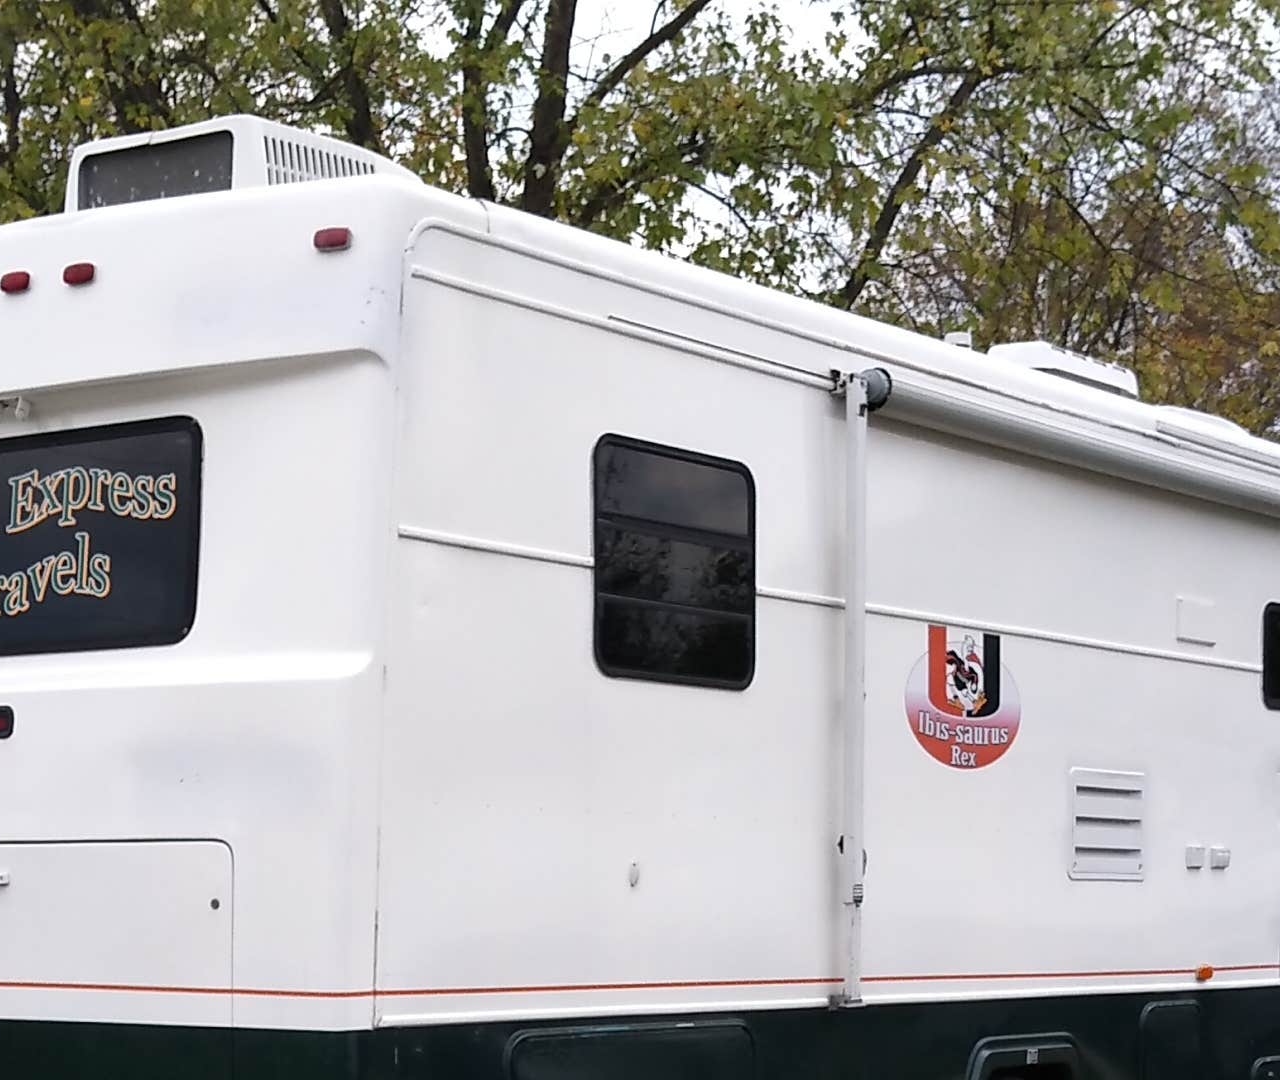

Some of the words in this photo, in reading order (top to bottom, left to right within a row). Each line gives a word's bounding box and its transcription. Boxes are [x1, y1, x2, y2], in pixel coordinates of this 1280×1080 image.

[6, 466, 177, 534] Express
[918, 711, 1008, 745] Ibis-saurus
[950, 745, 976, 767] Rex
